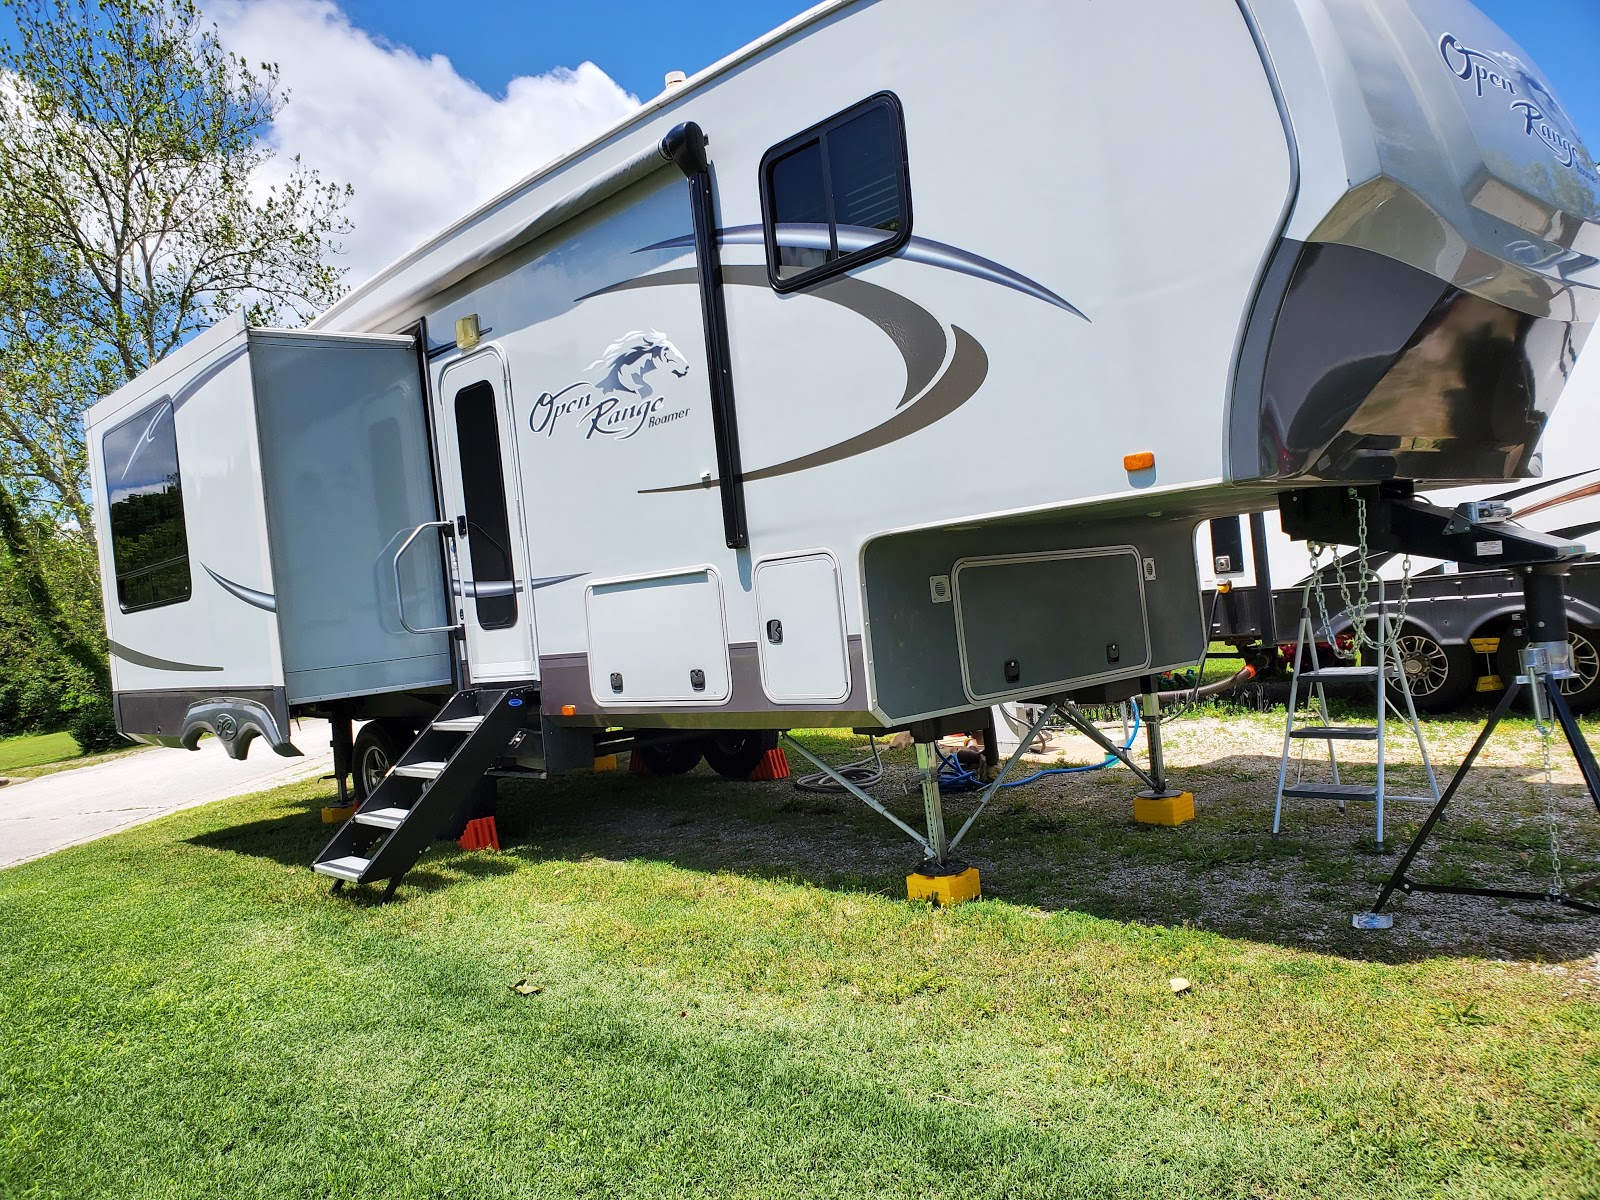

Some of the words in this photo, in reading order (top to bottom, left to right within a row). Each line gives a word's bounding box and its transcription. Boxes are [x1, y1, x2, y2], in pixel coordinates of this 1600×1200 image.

[1438, 32, 1517, 97] Open
[1510, 100, 1580, 168] Range
[529, 381, 594, 438] Open
[577, 396, 664, 440] Range
[648, 408, 690, 429] Roamer
